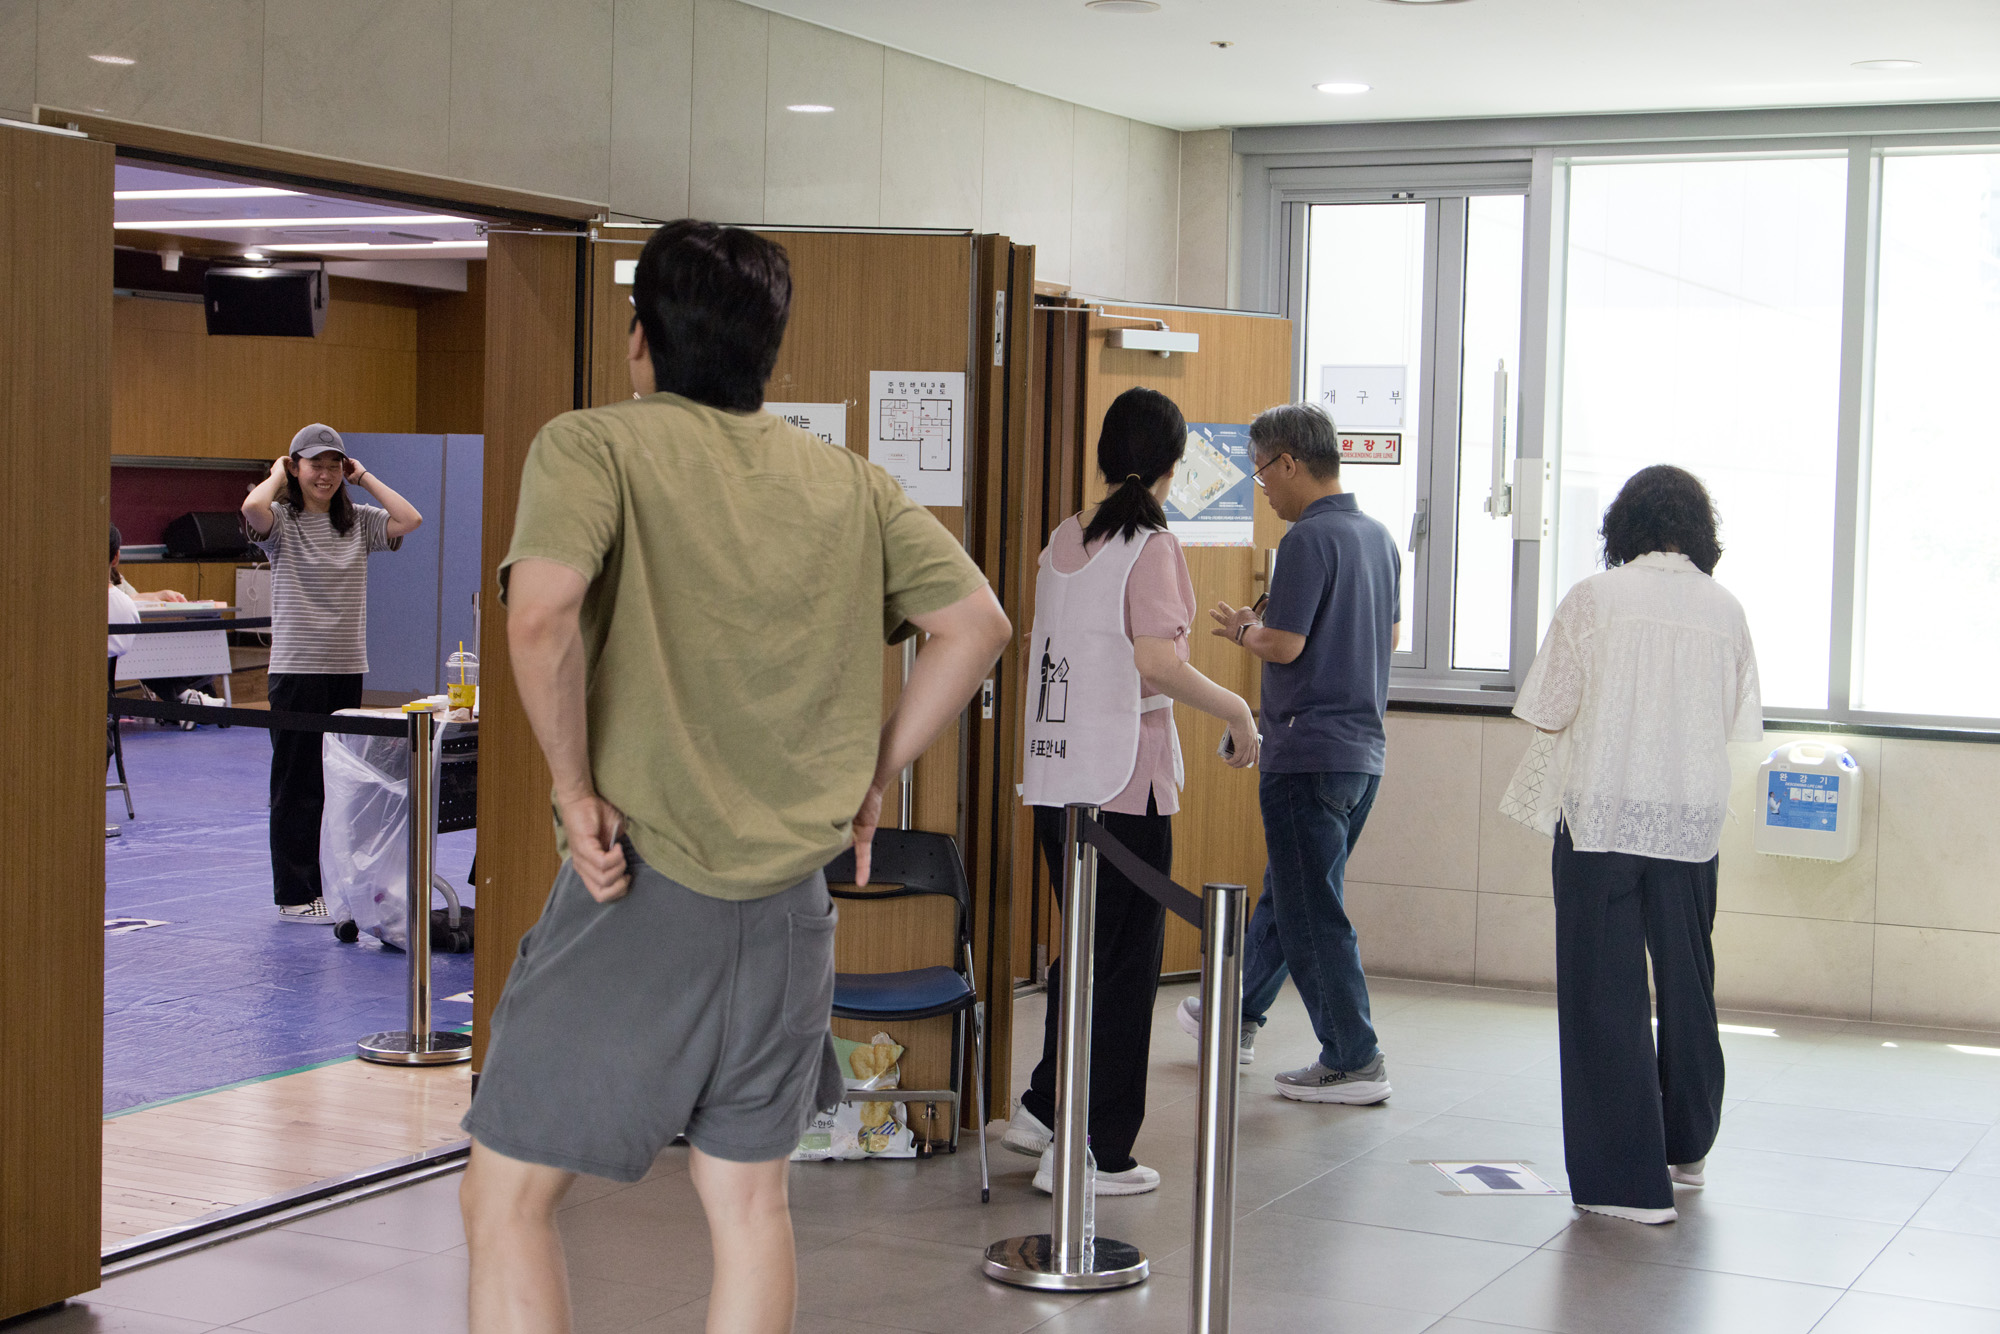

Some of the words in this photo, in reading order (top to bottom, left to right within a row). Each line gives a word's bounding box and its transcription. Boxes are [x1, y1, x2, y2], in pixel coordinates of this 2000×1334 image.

[1323, 389, 1402, 405] 개구부
[784, 414, 811, 429] 에는
[1342, 439, 1396, 452] 완강기
[1779, 772, 1828, 785] 완강기
[1320, 1071, 1347, 1085] HOKA
